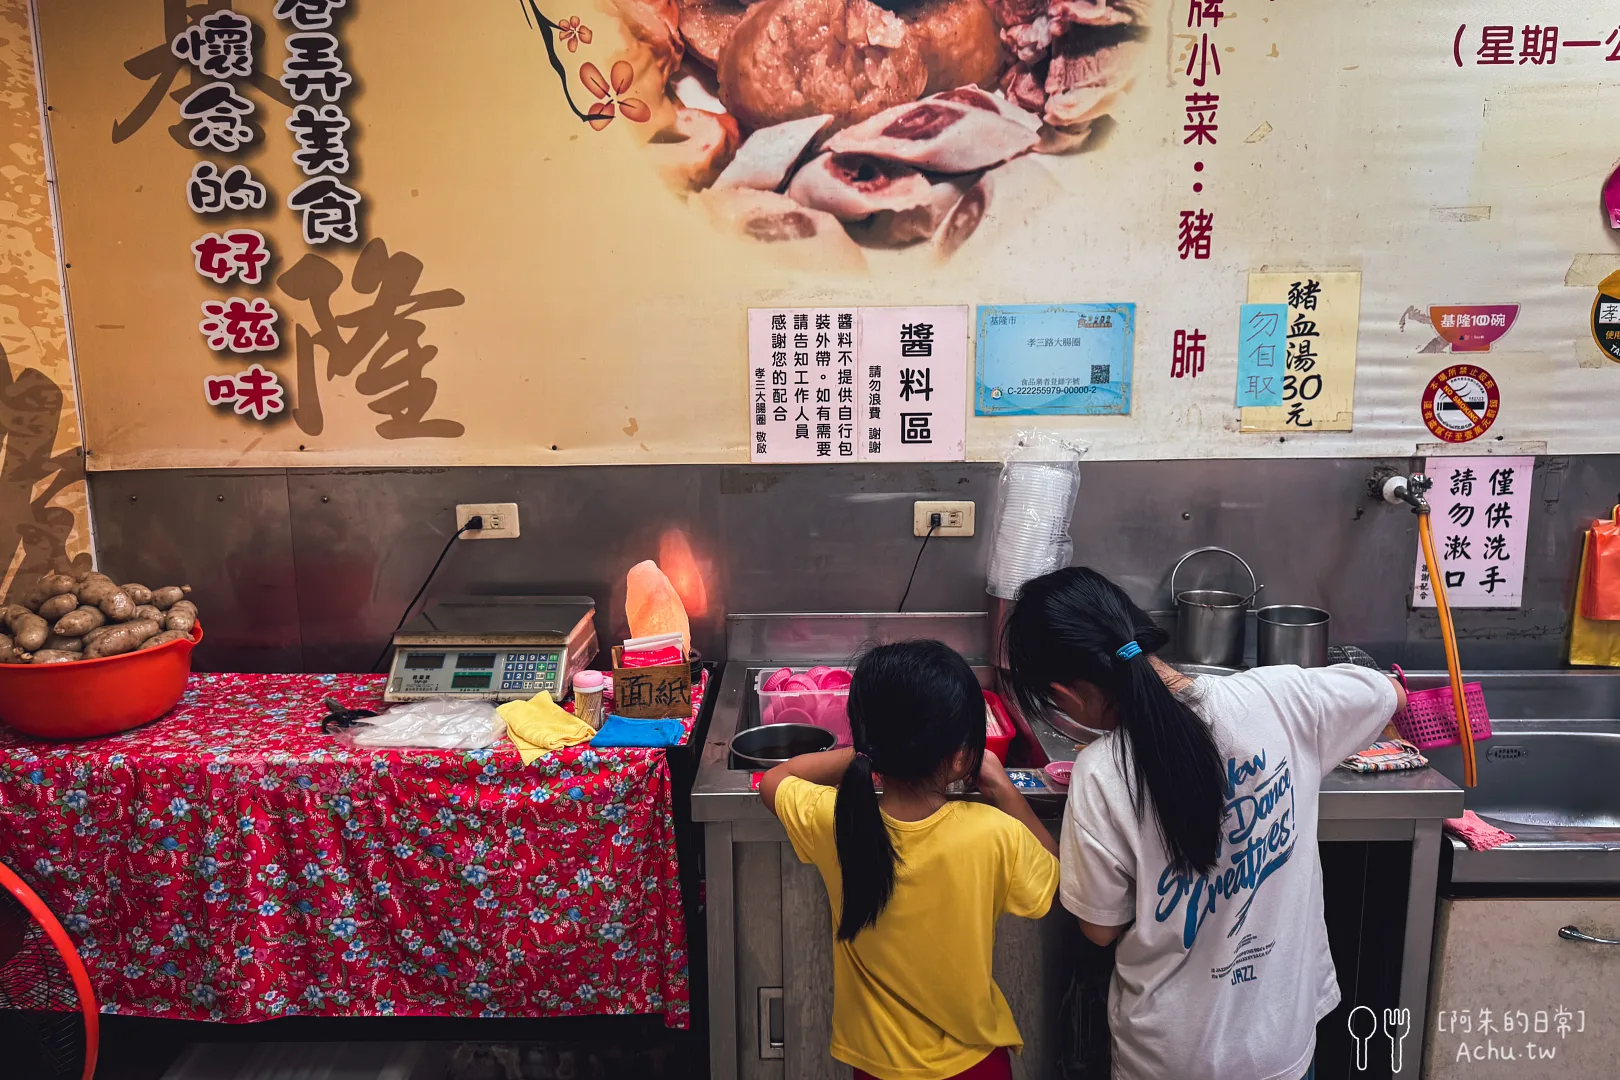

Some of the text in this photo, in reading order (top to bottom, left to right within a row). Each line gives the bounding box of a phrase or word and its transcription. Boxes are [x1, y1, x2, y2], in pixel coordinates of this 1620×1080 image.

[172, 10, 284, 420] 懷念的好滋味
[771, 314, 787, 422] 感謝您的配合
[990, 316, 1017, 326] 基隆市
[1026, 337, 1081, 348] 孝三路大腸圈
[793, 314, 809, 439] 請告知工作人員
[815, 313, 831, 457] 裝外帶。如有需要
[837, 313, 853, 457] 醬料不提供自行包
[868, 365, 882, 454] 請勿浪費 謝謝
[899, 323, 935, 445] 醬料區
[1007, 386, 1097, 396] C-222255979-00000-2
[1443, 385, 1453, 396] NO
[1453, 395, 1479, 423] SMOKING
[1443, 468, 1477, 588] 請勿漱口
[1479, 467, 1515, 593] 僅供洗手
[620, 674, 690, 708] 面紙
[1223, 767, 1291, 845] Dance
[1231, 965, 1257, 986] JAZZ
